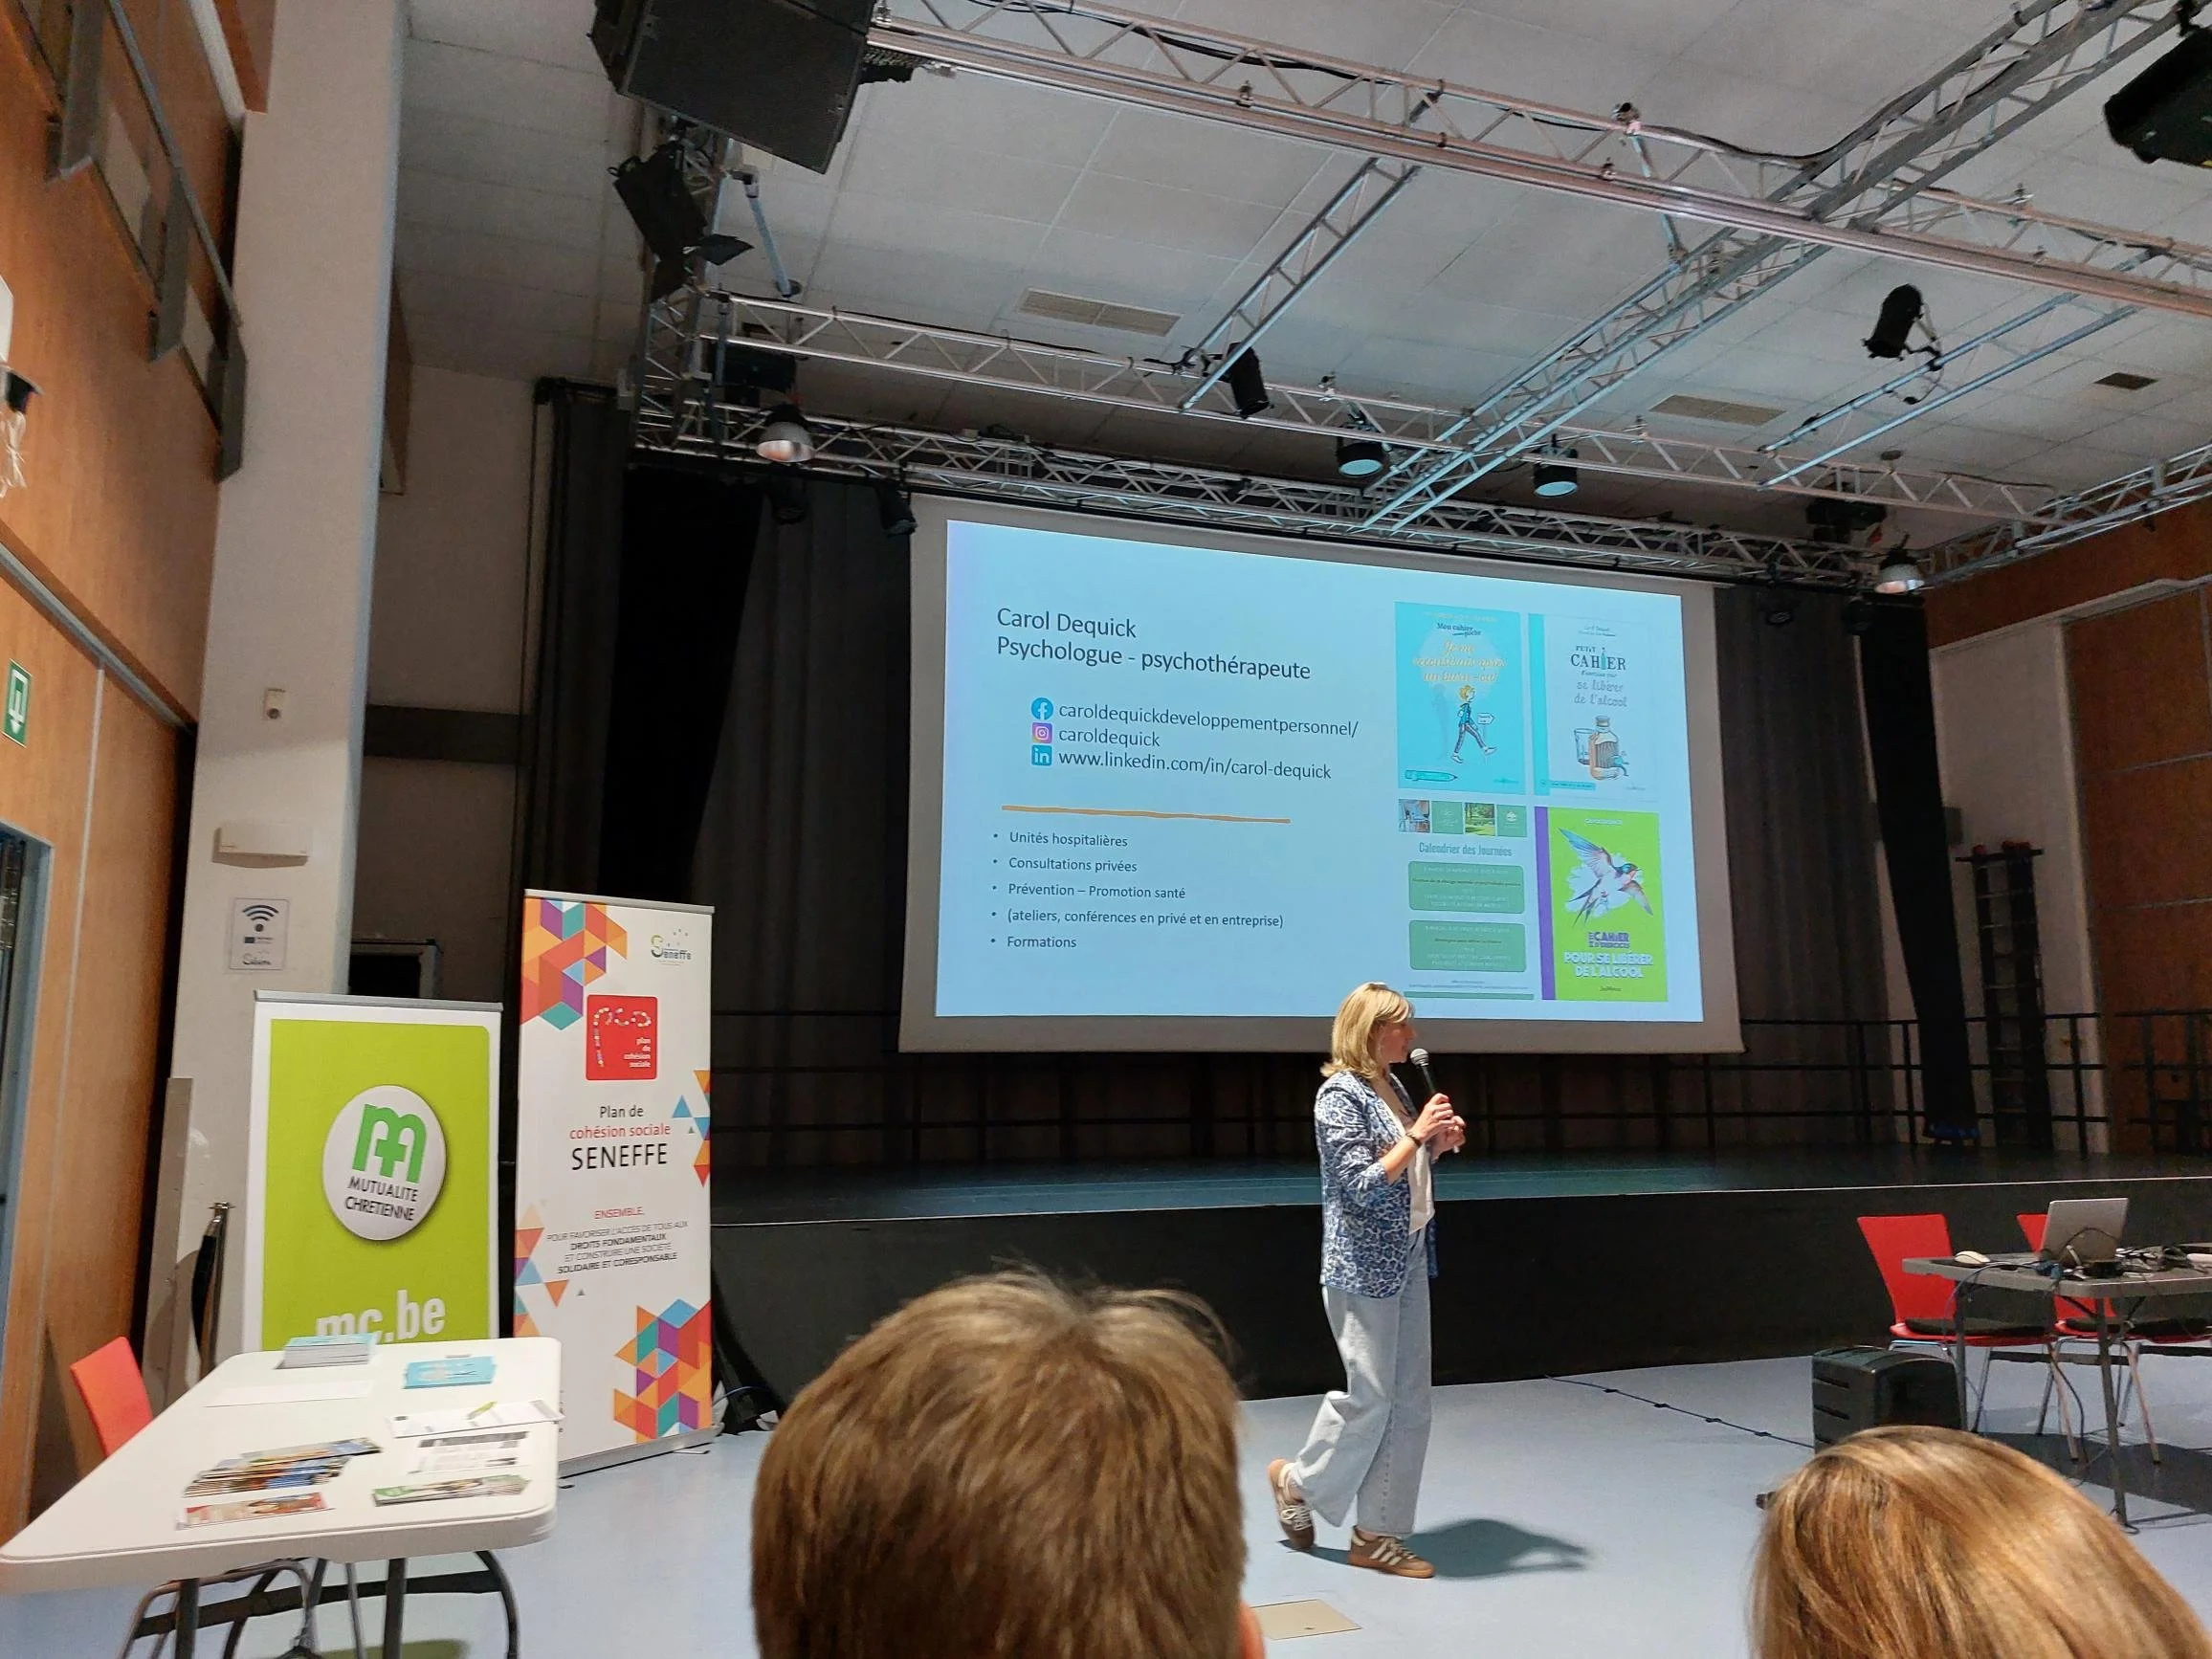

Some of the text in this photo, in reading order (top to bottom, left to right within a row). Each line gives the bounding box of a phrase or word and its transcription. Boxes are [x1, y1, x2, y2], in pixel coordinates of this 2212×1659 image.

[997, 608, 1137, 638] Carol Dequick
[997, 636, 1123, 667] Psychologue
[1141, 652, 1312, 680] psychothérapeute
[1570, 647, 1626, 671] CAHIER
[1058, 704, 1360, 738] caroldequickdeveloppementpersonnel/
[1058, 728, 1161, 747] caroldequick
[1058, 752, 1332, 780] www.linkedin.com/in/carol-dequick
[1009, 831, 1128, 848] Unités hospitalières
[1419, 842, 1514, 857] Calendrier des Journées
[1008, 857, 1138, 874] Consultations privées
[1008, 883, 1074, 896] Prévention
[1089, 886, 1151, 899] Promotion
[1154, 887, 1186, 899] santé
[1007, 908, 1284, 929] (ateliers, conférences en privé et en entreprise)
[1006, 936, 1077, 949] Formations
[599, 1105, 644, 1118] Plan de
[569, 1123, 672, 1140] cohésion sociale
[571, 1142, 668, 1171] SENEFFE
[347, 1176, 419, 1203] MUTUALITE
[345, 1196, 415, 1222] CHRETIENNE
[546, 1232, 568, 1242] POUR
[570, 1228, 609, 1241] FAVORISER
[642, 1224, 653, 1233] DE
[653, 1223, 672, 1231] TOUS
[674, 1220, 689, 1229] AUX
[570, 1232, 667, 1250] DROITS FONDAMENTAUX
[557, 1252, 678, 1274] SOLIDAIRE ET CORESPONSABLE
[576, 1249, 623, 1261] CONSTRUIRE
[625, 1246, 640, 1254] UNE
[316, 1289, 447, 1343] mc.be
